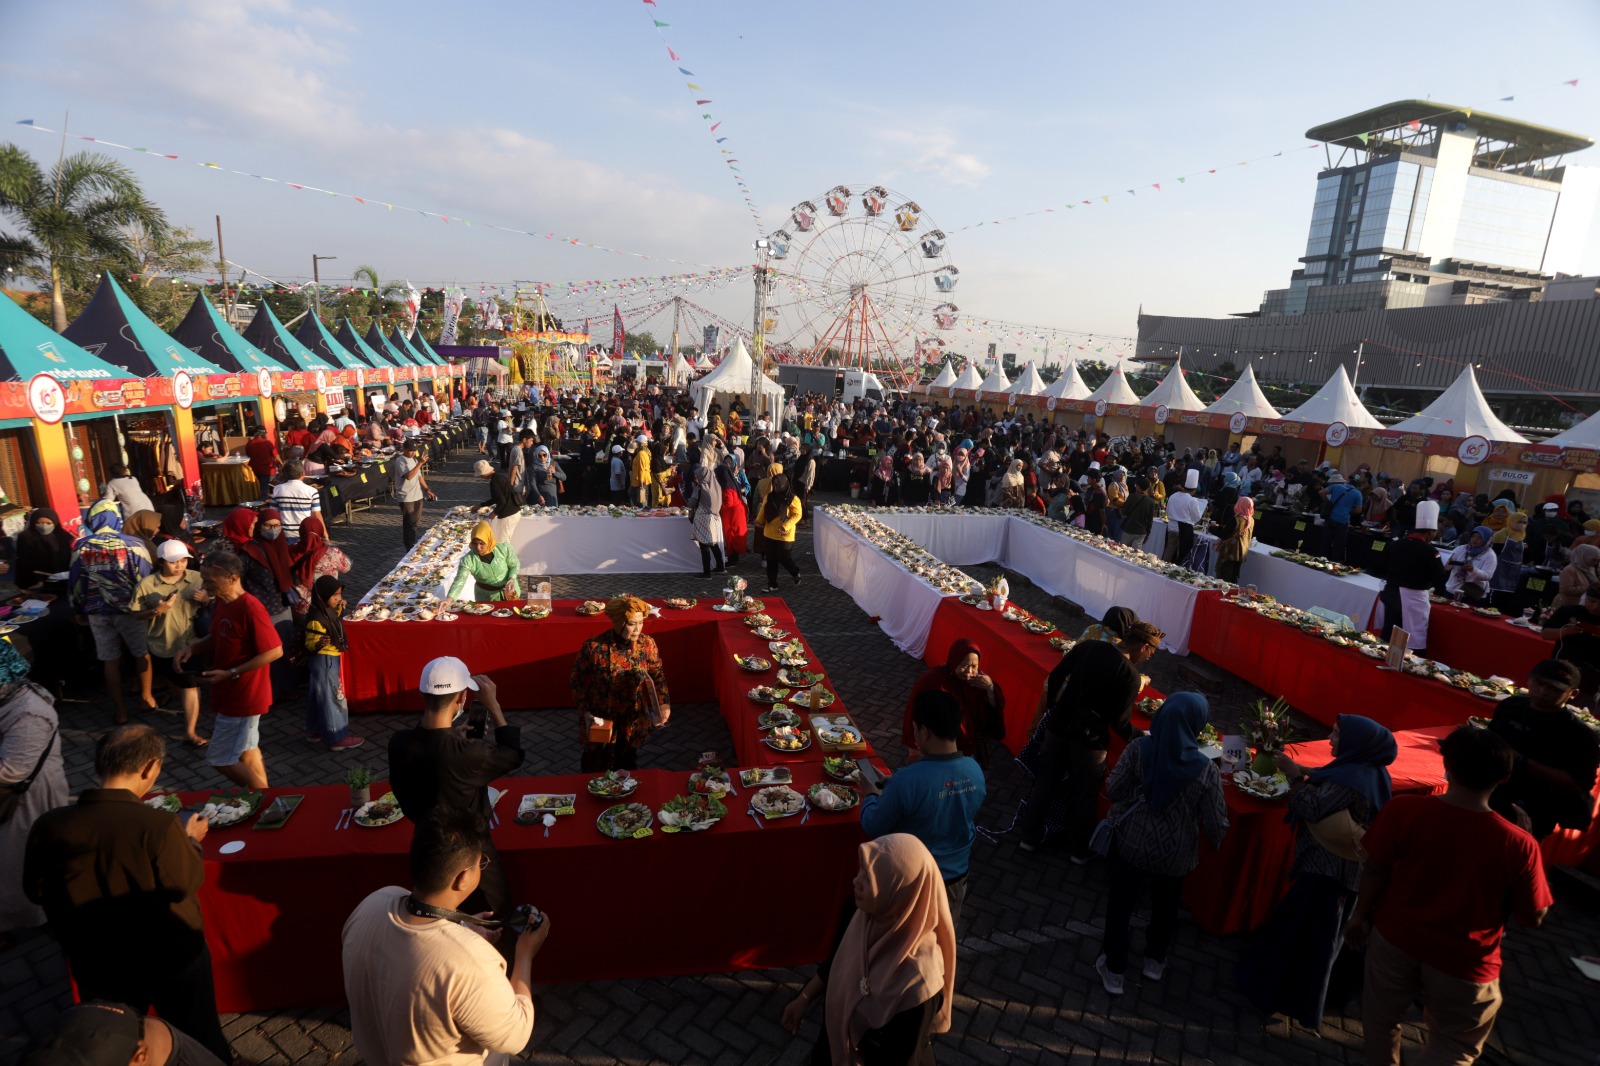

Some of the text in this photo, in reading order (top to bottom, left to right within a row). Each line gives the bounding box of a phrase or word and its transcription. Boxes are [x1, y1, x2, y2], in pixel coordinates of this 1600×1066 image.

[1567, 449, 1598, 459] FESTIVAL
[1565, 457, 1598, 466] KULINER
[1502, 471, 1529, 480] BULOG
